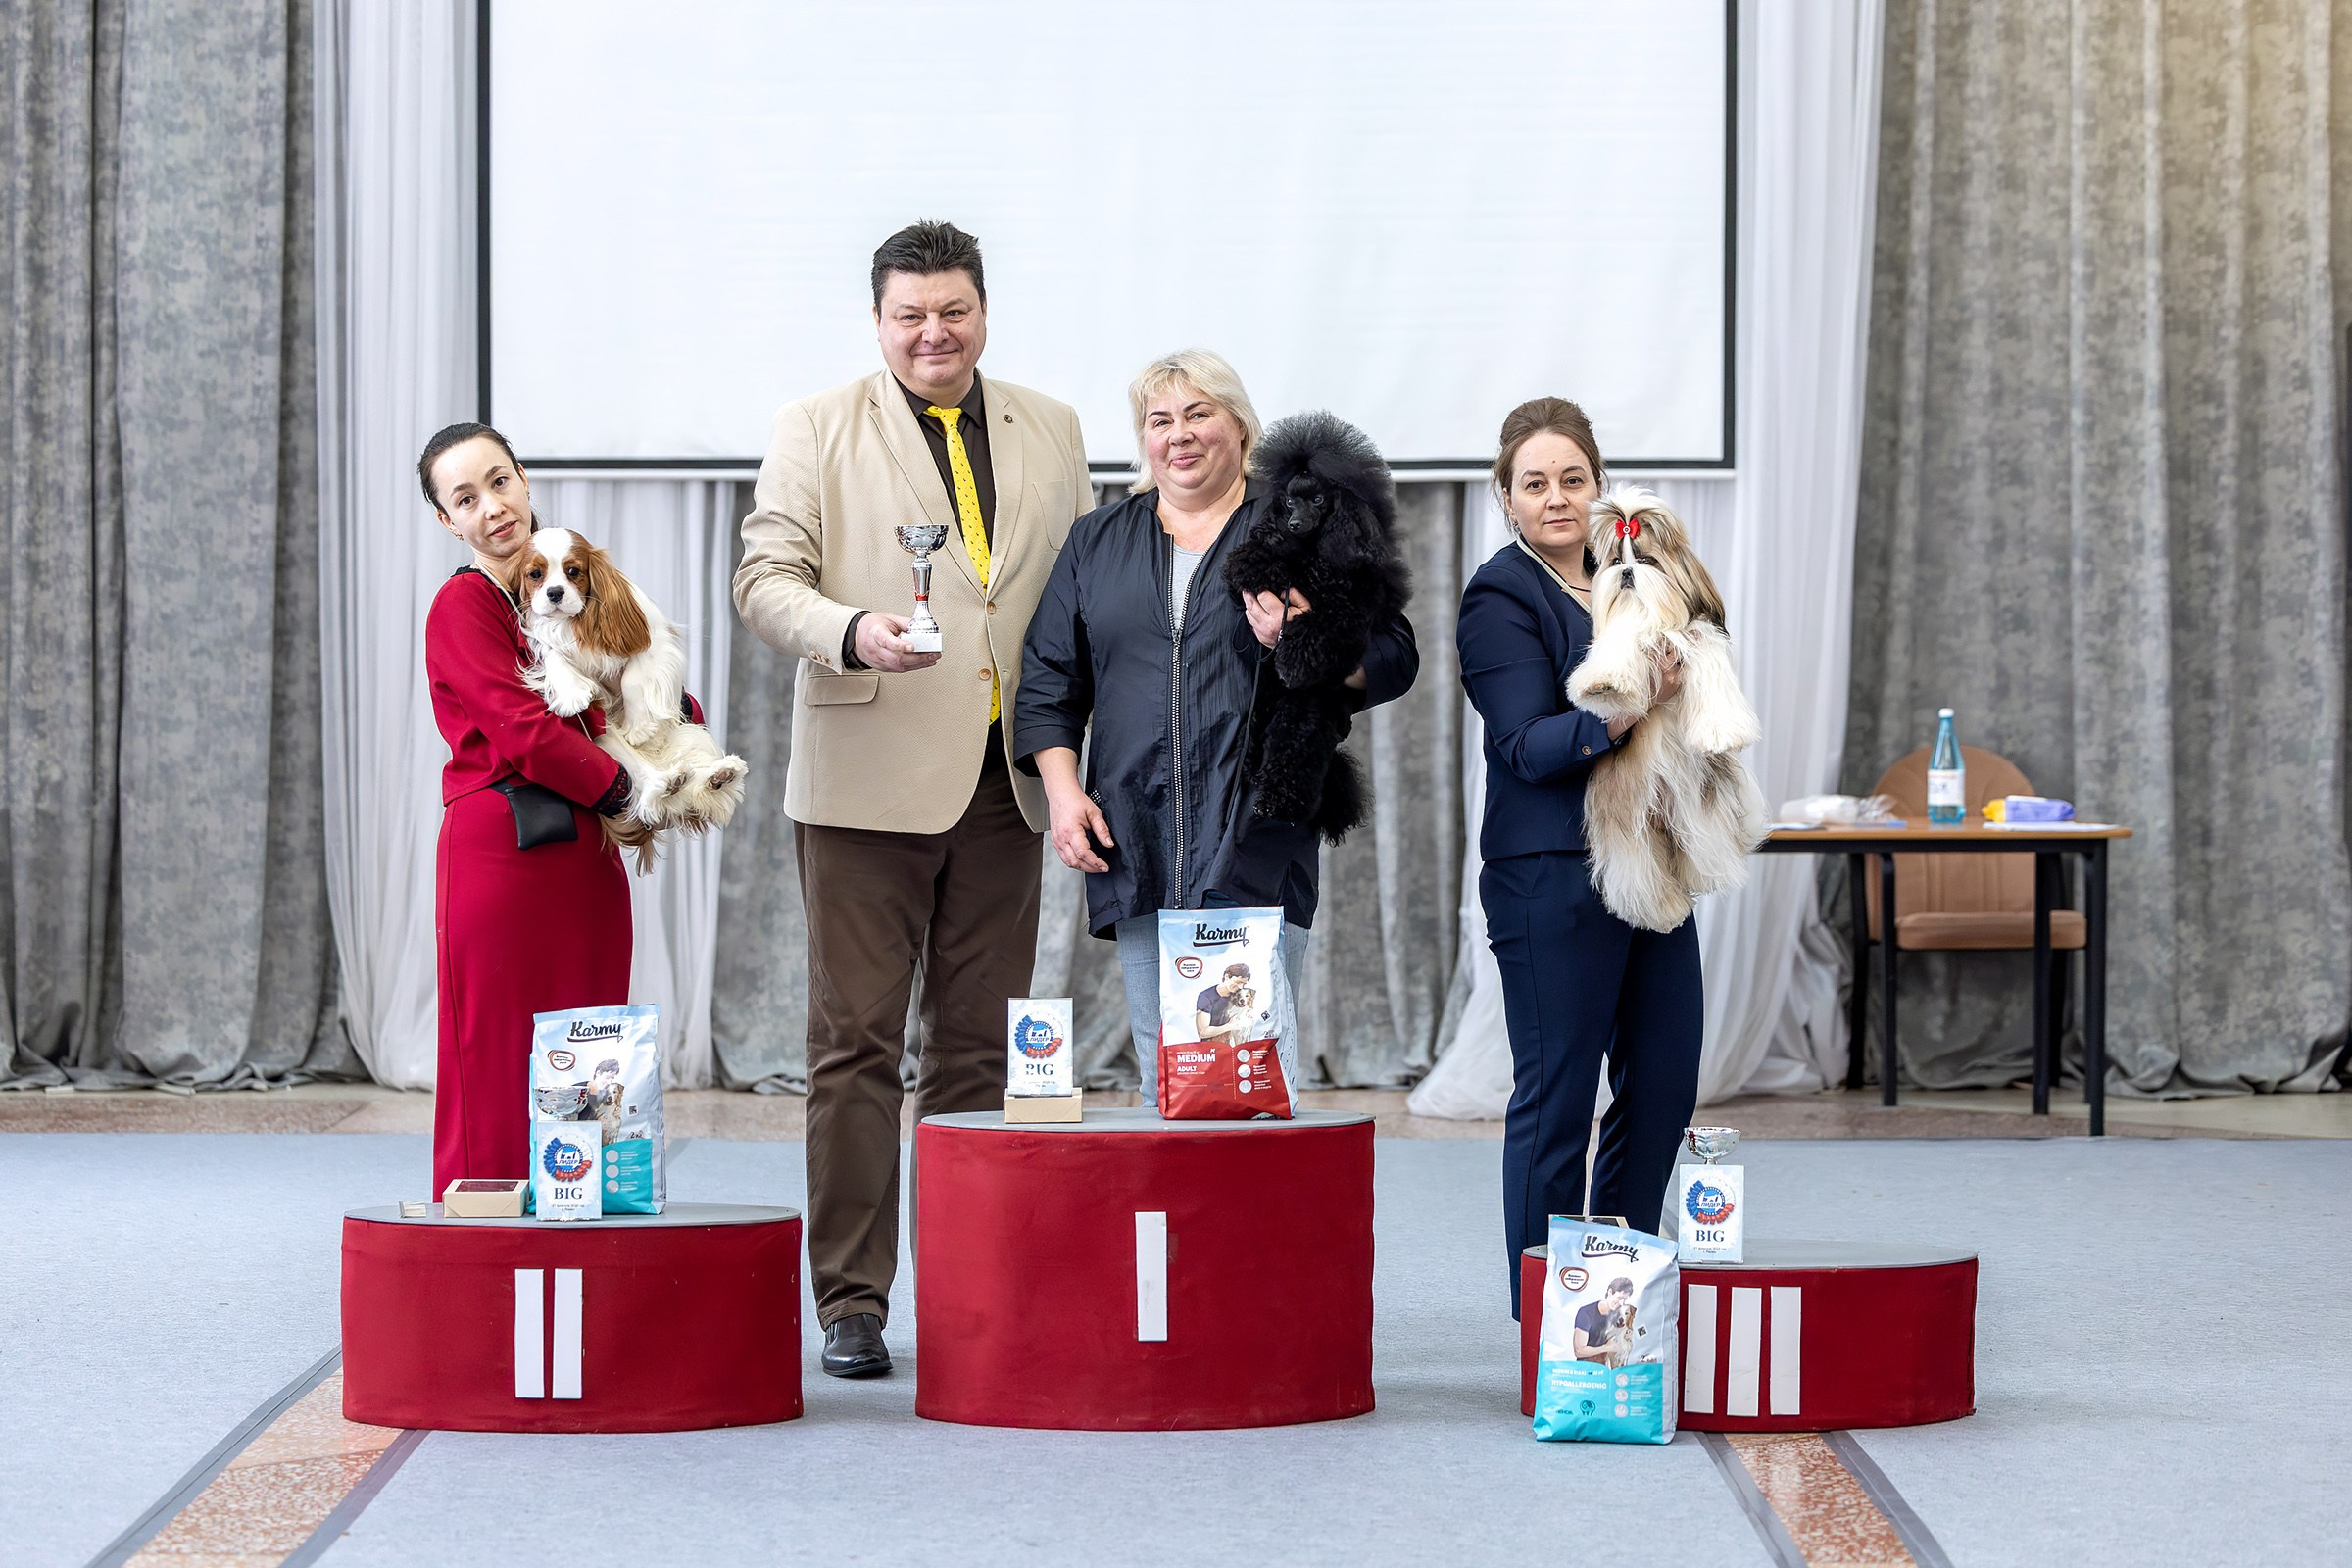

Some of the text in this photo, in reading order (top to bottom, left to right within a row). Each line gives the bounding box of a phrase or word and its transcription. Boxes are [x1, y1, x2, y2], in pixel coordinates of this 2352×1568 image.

[1193, 923, 1250, 947] Karmy
[567, 1021, 624, 1043] Karmy
[1177, 1054, 1215, 1063] MEDIUM
[1025, 1064, 1054, 1075] BIG
[554, 1187, 583, 1200] BIG
[1695, 1230, 1725, 1243] BIG
[1581, 1235, 1639, 1262] Karmy
